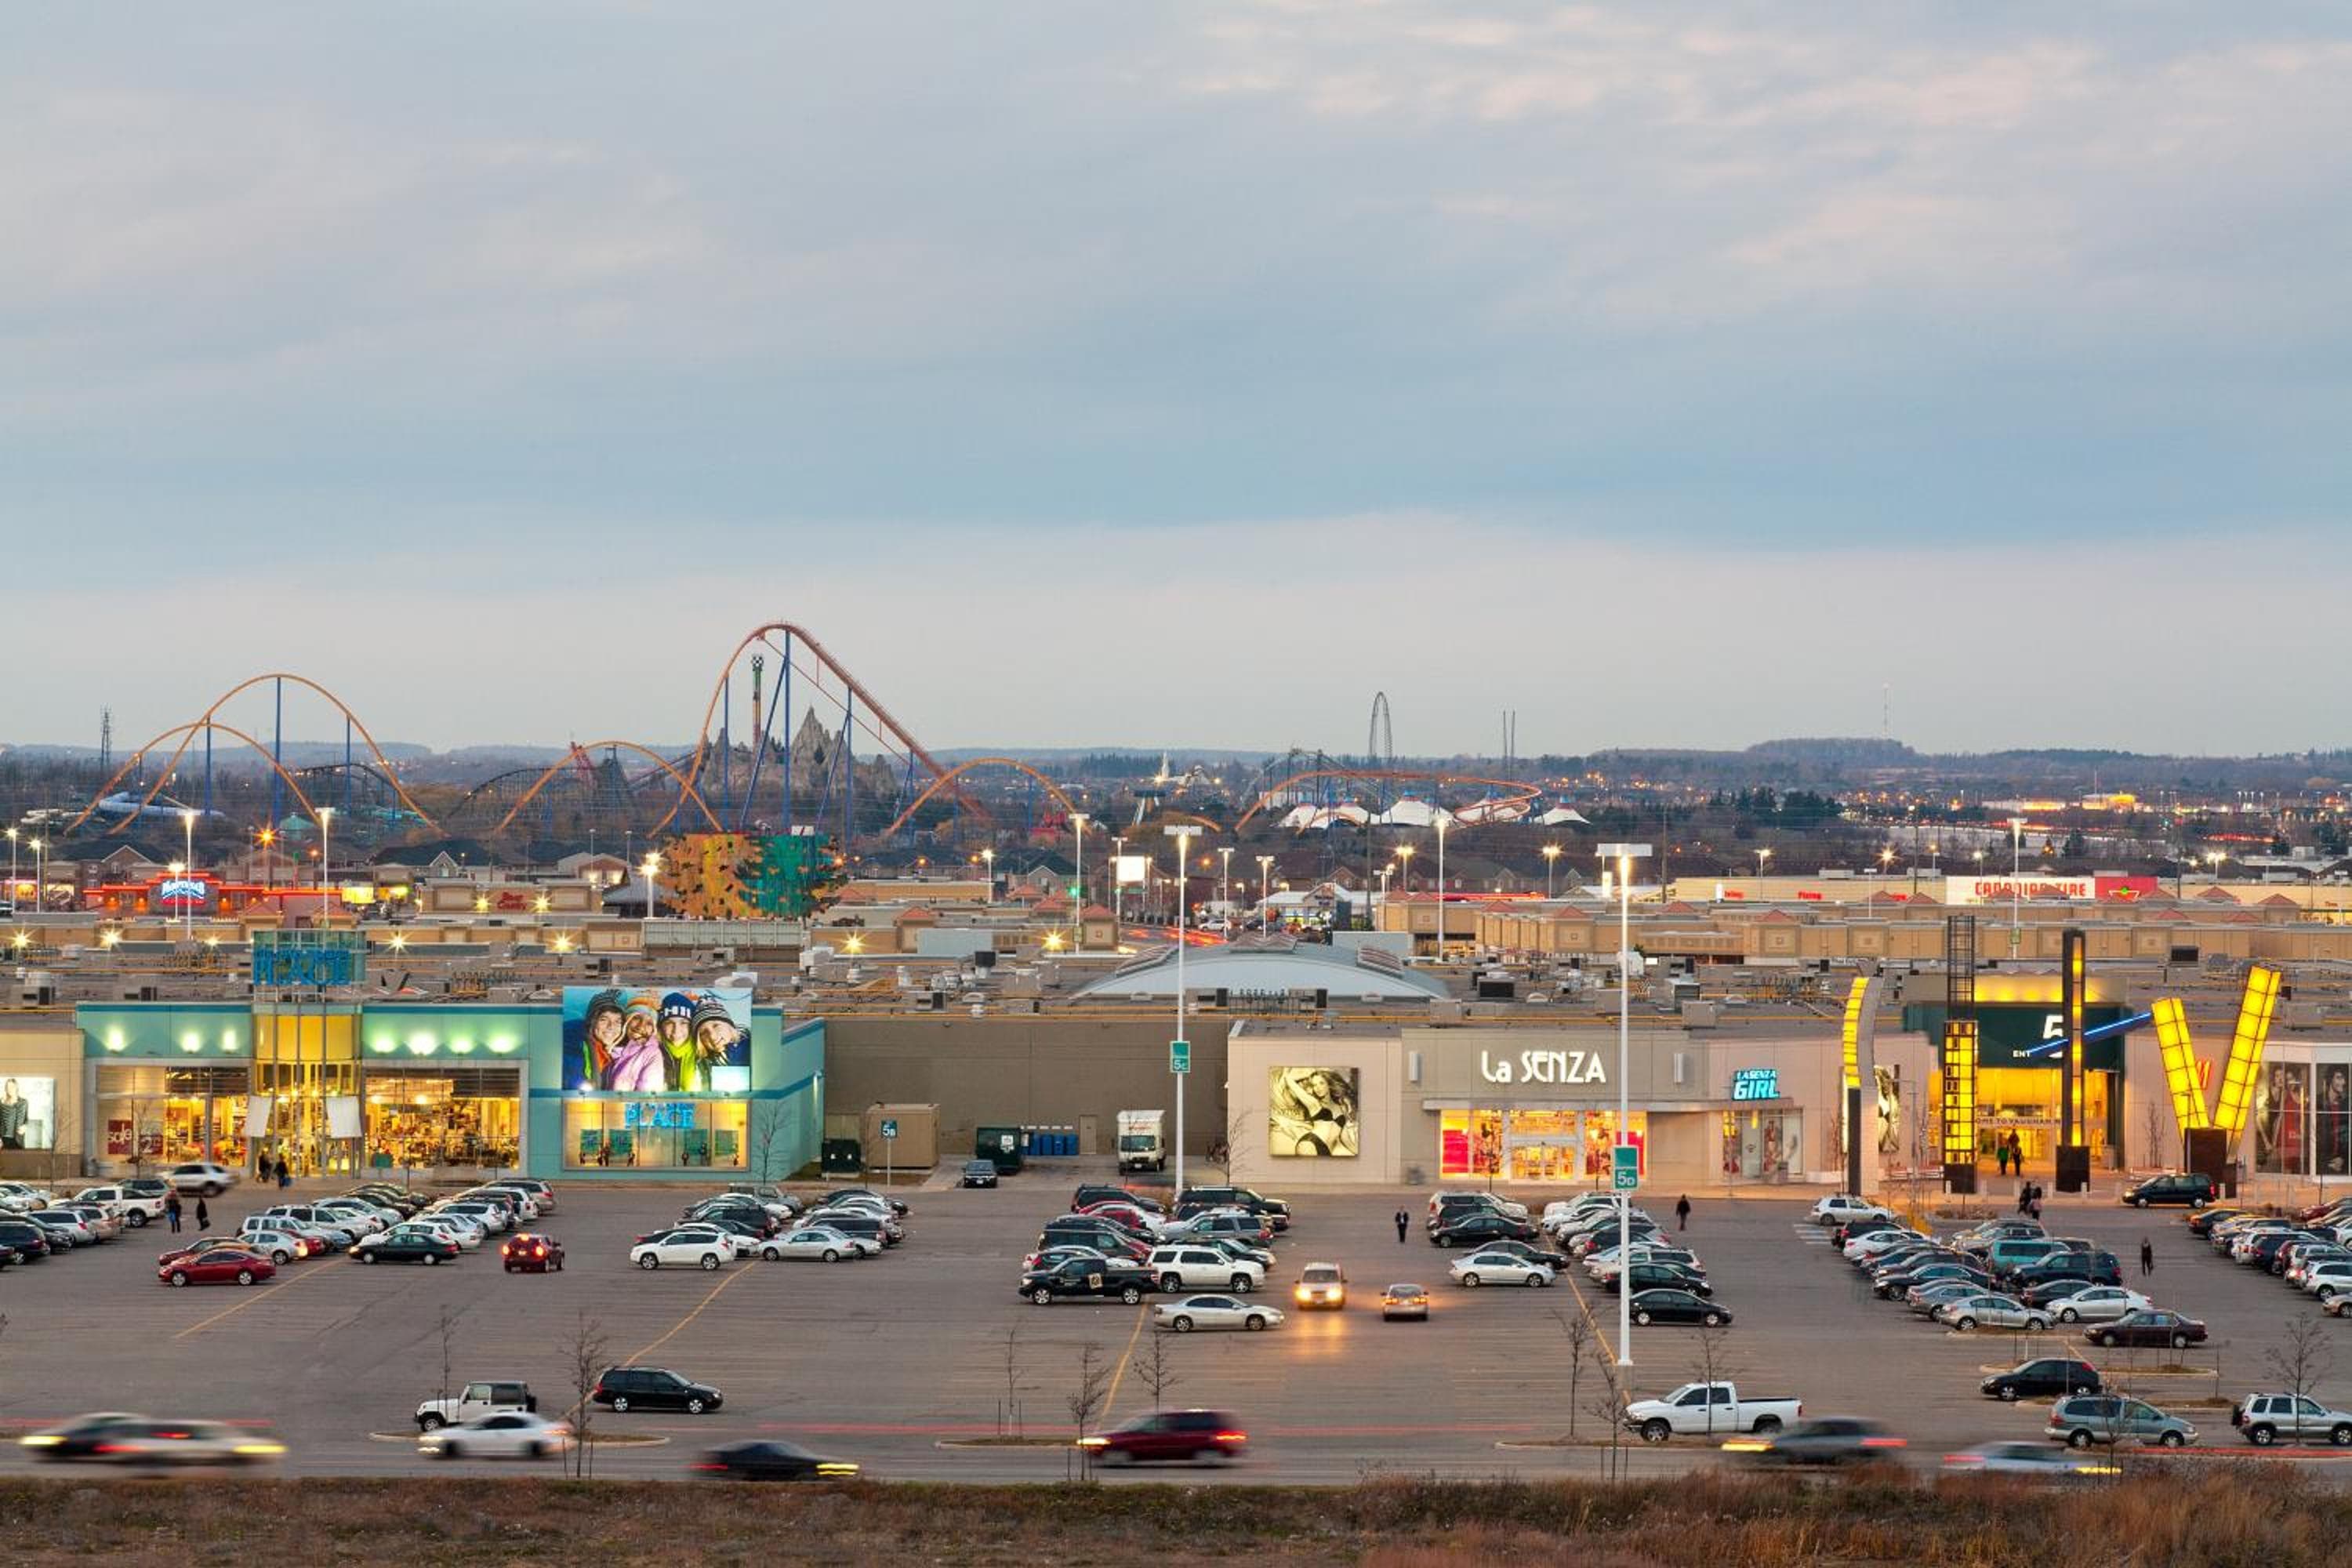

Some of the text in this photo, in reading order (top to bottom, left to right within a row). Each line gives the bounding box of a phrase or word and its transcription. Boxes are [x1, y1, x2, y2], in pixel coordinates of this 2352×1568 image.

[1481, 1050, 1606, 1083] La SENZA
[1733, 1080, 1780, 1099] GIRL
[1617, 1171, 1635, 1185] 5D
